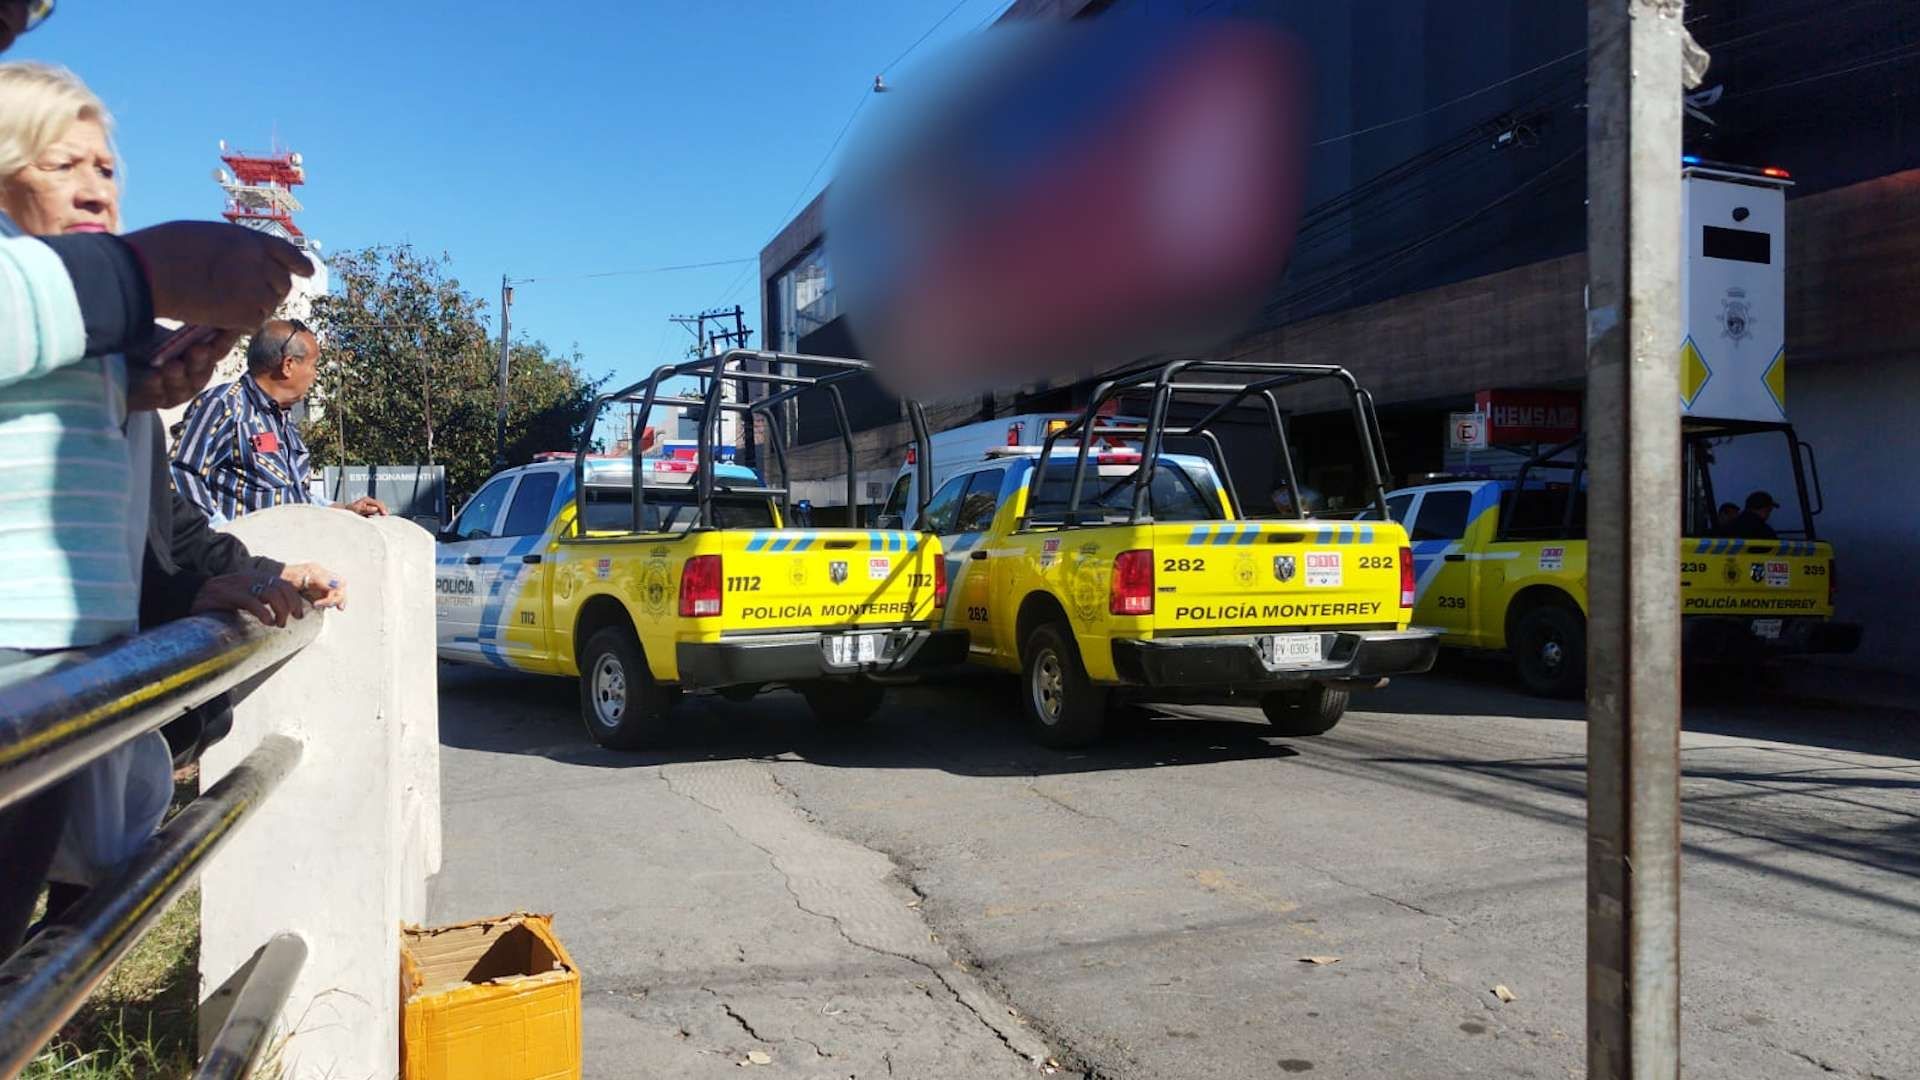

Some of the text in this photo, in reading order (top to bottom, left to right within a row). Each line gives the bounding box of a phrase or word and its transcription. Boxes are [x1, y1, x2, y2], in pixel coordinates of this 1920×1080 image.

[1163, 559, 1206, 572] 282
[1359, 557, 1394, 569] 282
[1803, 565, 1826, 576] 239
[436, 576, 475, 594] POLICÍA
[727, 576, 762, 592] 1112
[907, 574, 932, 588] 1112
[1438, 596, 1466, 609] 239
[1685, 596, 1816, 609] POLICÍA MONTERREY
[520, 611, 537, 625] 1112
[741, 602, 918, 620] POLICÍA MONTERREY
[968, 607, 989, 622] 282
[1175, 602, 1382, 621] POLICÍA MONTERREY
